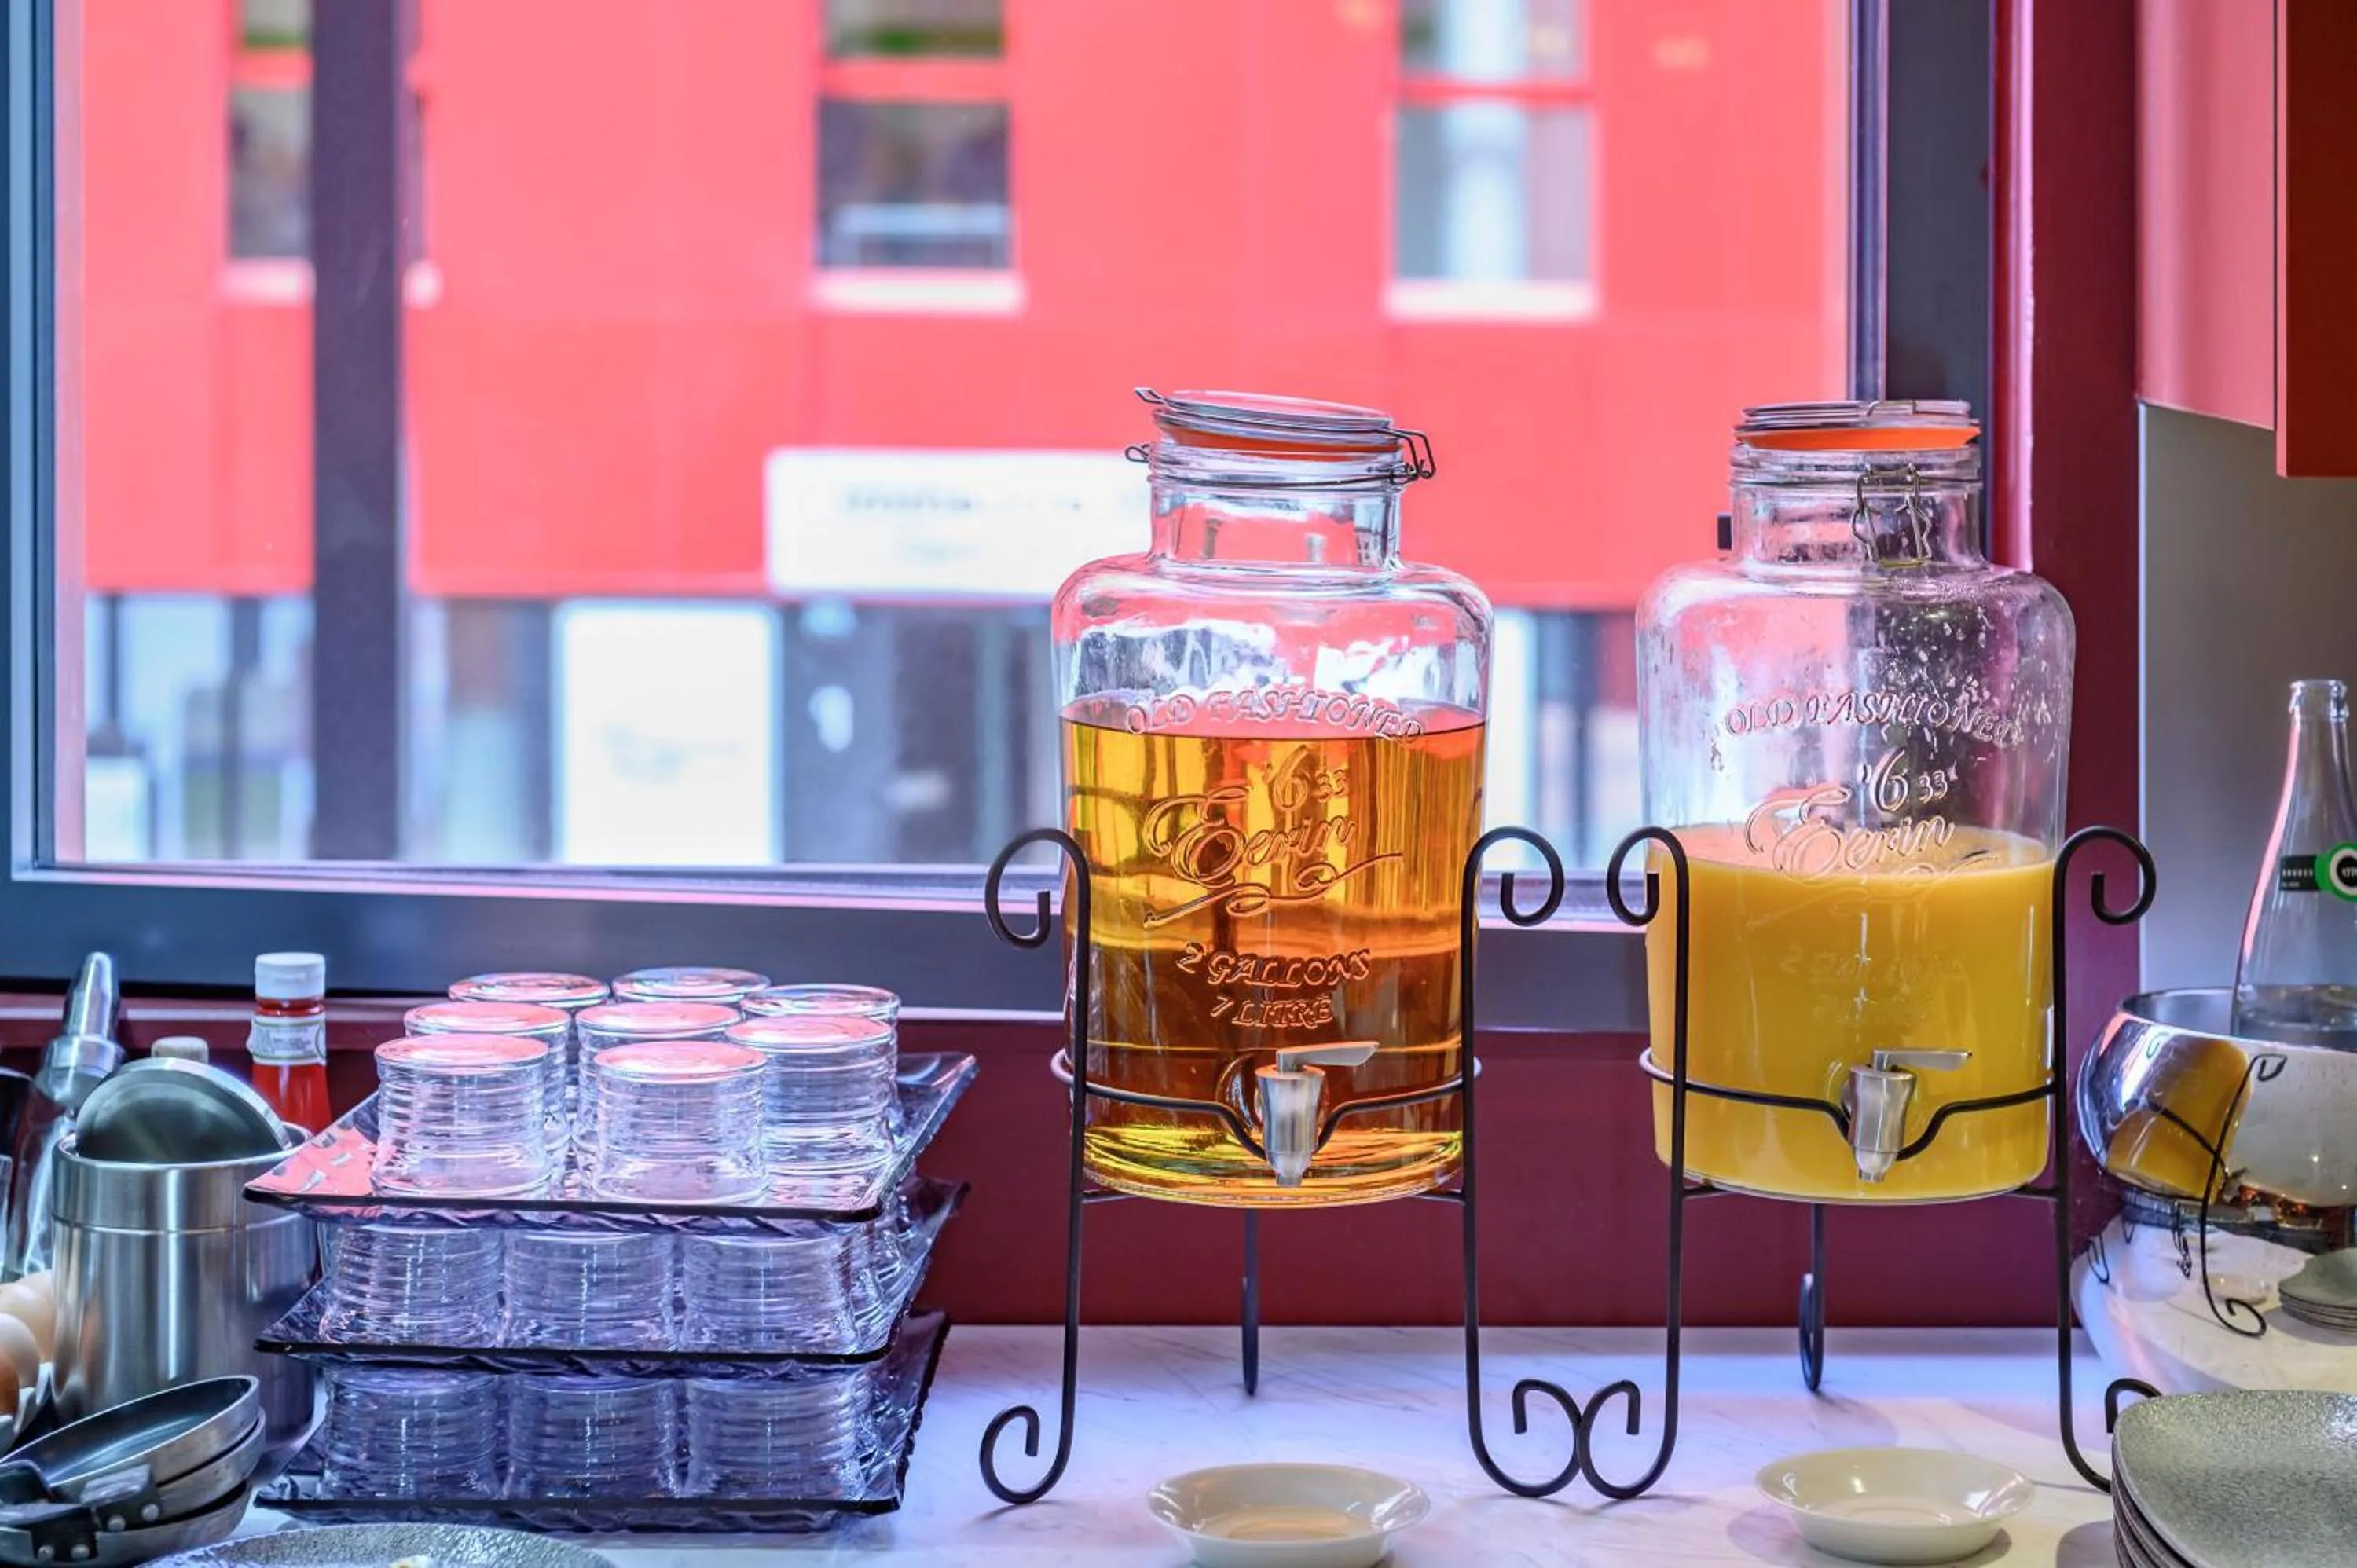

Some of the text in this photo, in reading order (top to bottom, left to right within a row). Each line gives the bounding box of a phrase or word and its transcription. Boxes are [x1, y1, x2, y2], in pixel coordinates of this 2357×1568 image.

[1126, 688, 1424, 743] OLD FASHIONED
[1726, 698, 1795, 738] OLD
[1176, 941, 1371, 988] 2 GALLONS
